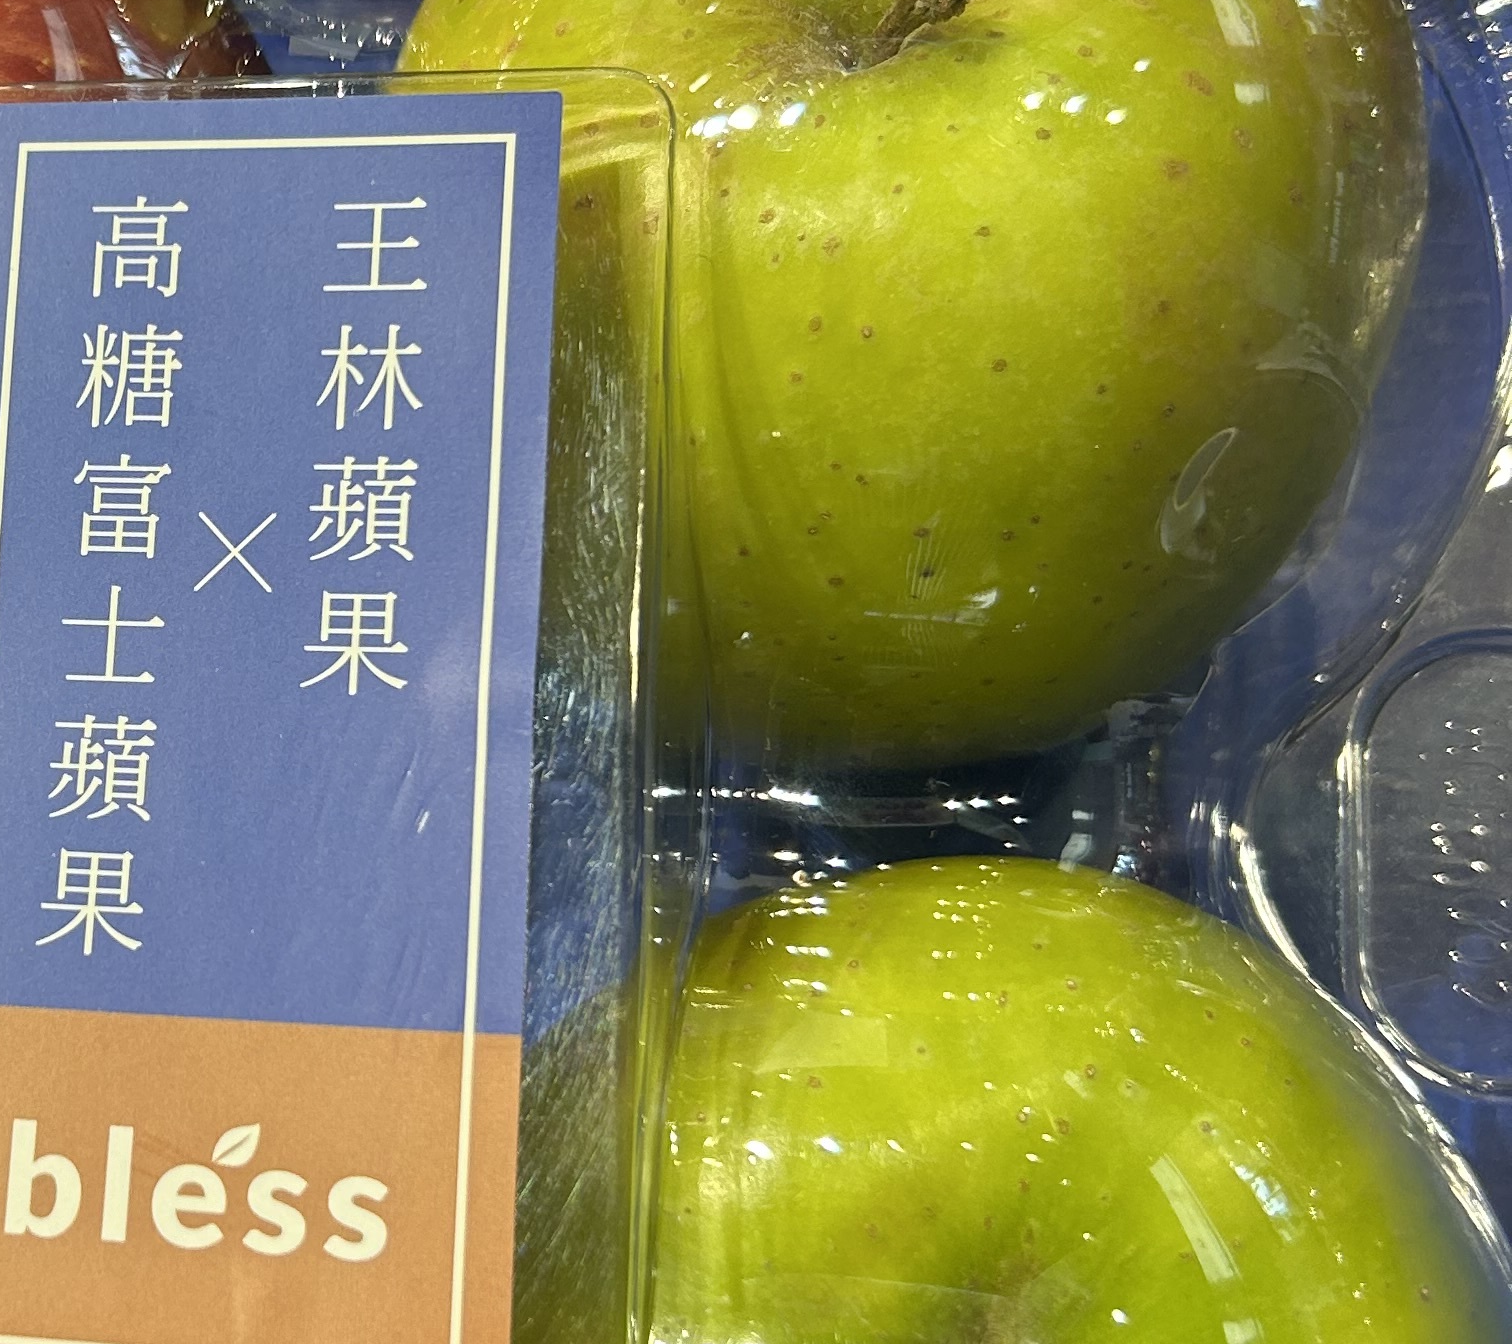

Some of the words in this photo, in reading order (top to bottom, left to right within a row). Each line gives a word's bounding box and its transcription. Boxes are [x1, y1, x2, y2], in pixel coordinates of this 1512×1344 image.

[34, 196, 190, 957] 高糖富士蘋果
[299, 196, 428, 697] 王林蘋果
[3, 1117, 390, 1264] bless
